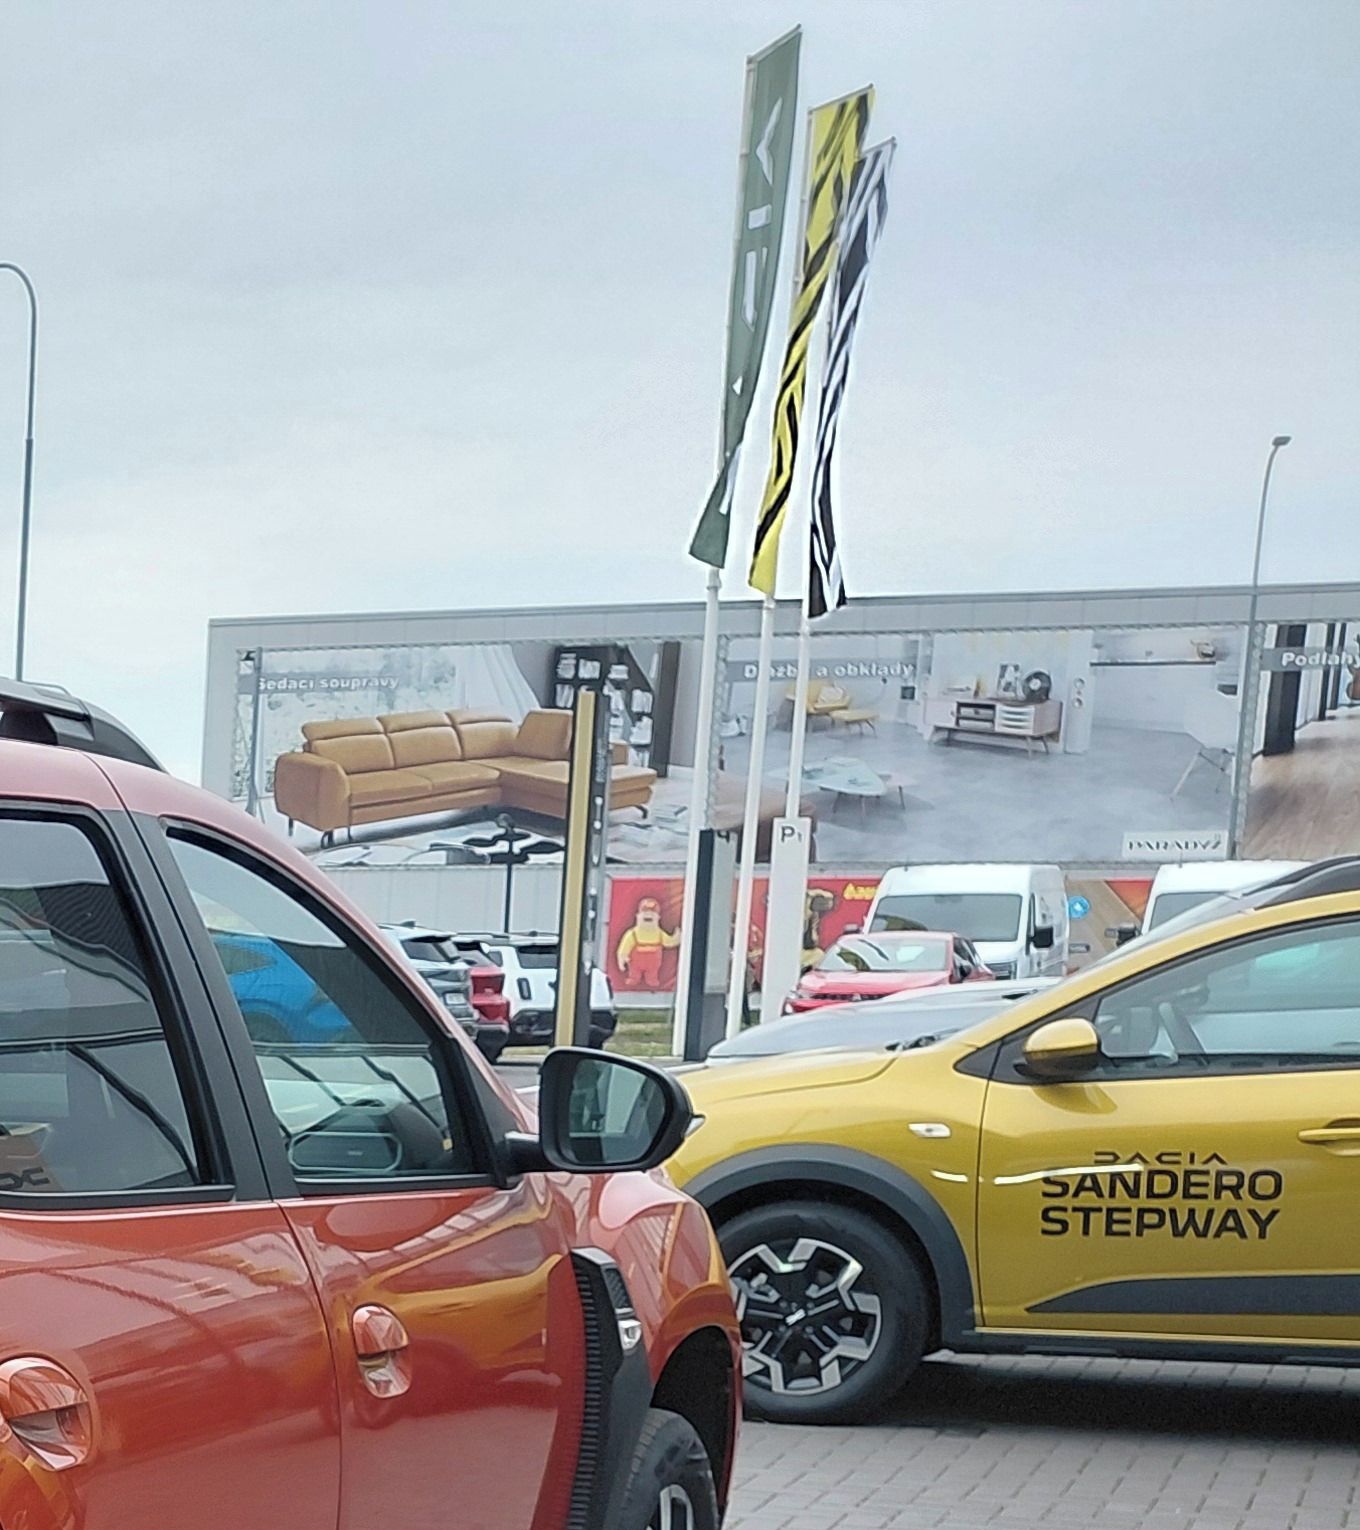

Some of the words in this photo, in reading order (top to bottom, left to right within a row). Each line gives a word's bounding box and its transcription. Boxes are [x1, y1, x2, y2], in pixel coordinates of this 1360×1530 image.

[316, 676, 399, 689] soupravy
[1094, 1151, 1228, 1165] DACIA
[1042, 1169, 1283, 1201] SANDERO
[1041, 1206, 1281, 1240] STEPWAY
